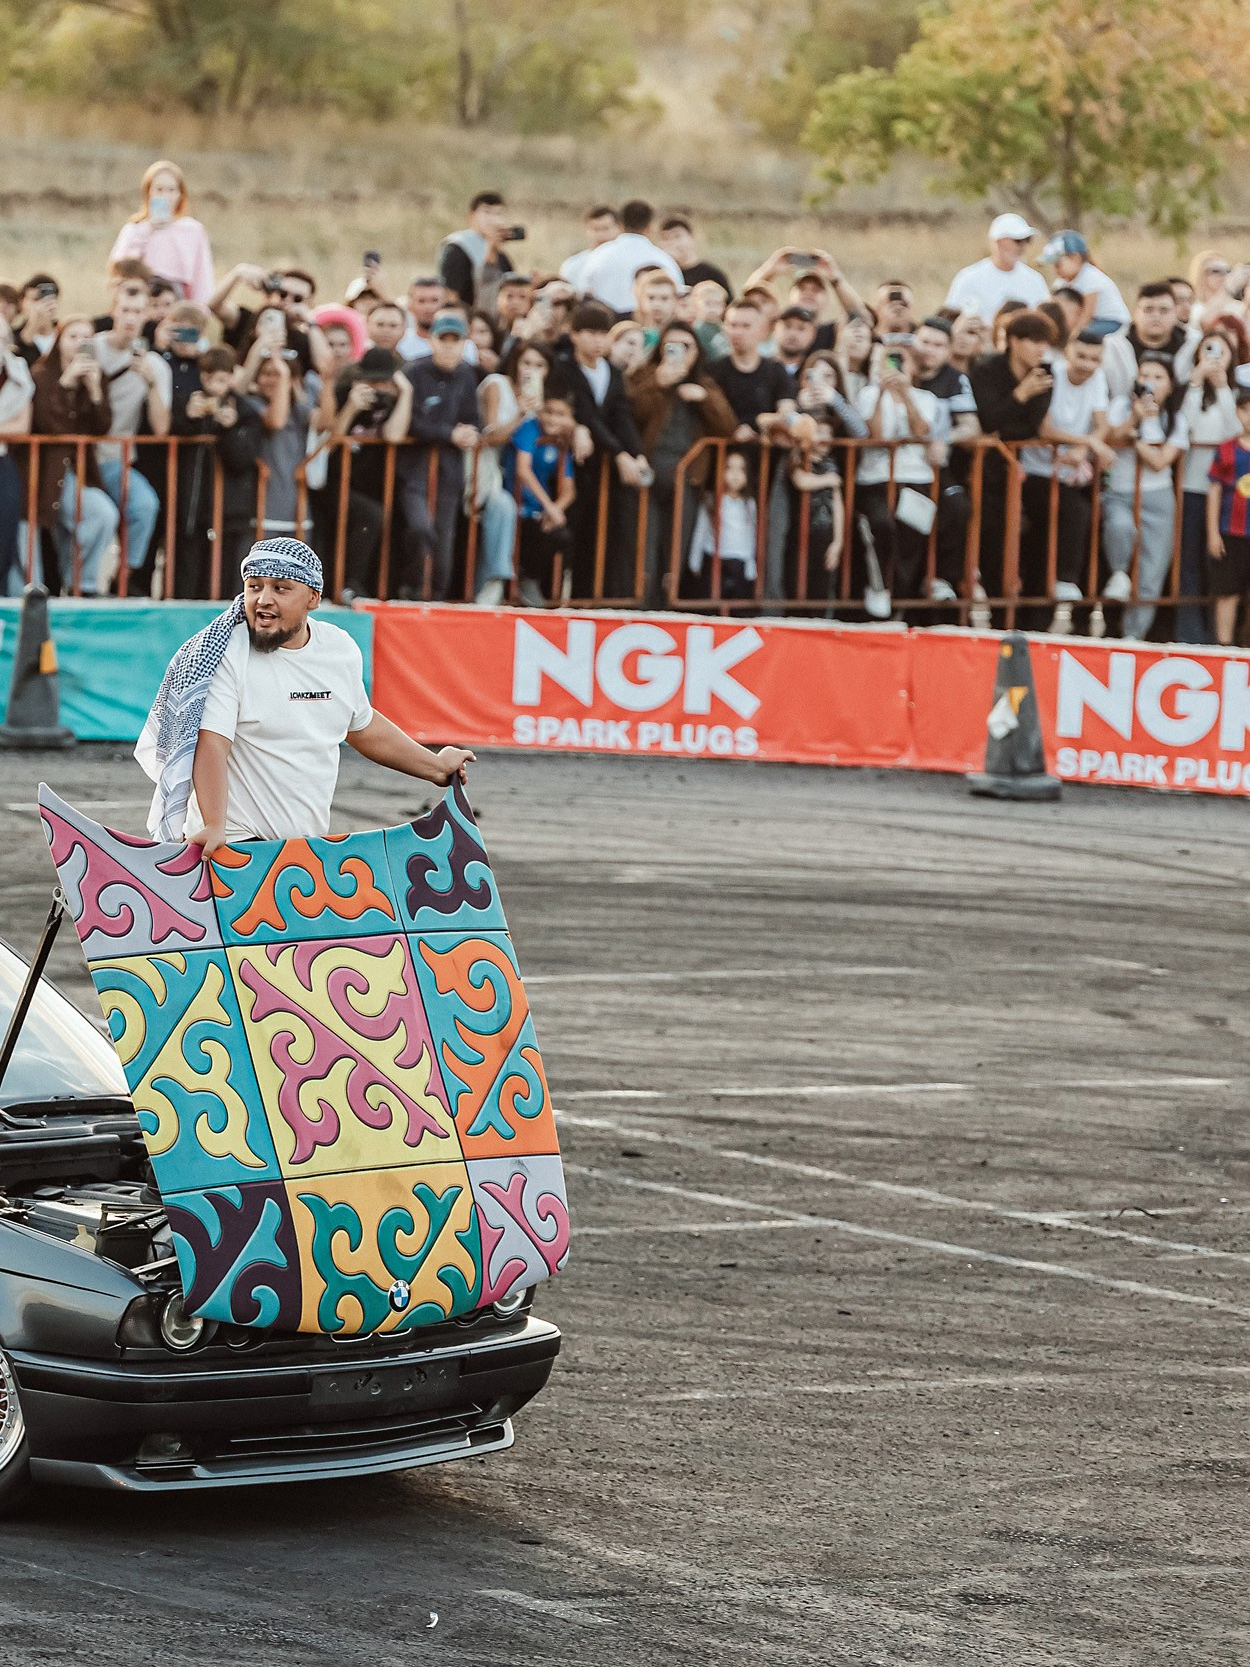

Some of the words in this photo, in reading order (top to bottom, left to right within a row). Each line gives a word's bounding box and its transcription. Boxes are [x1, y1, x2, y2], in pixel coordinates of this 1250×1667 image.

[512, 618, 764, 720] NGK
[513, 715, 631, 749] SPARK
[638, 721, 759, 756] PLUGS
[1056, 747, 1168, 784] SPARK
[1173, 757, 1250, 791] PLU
